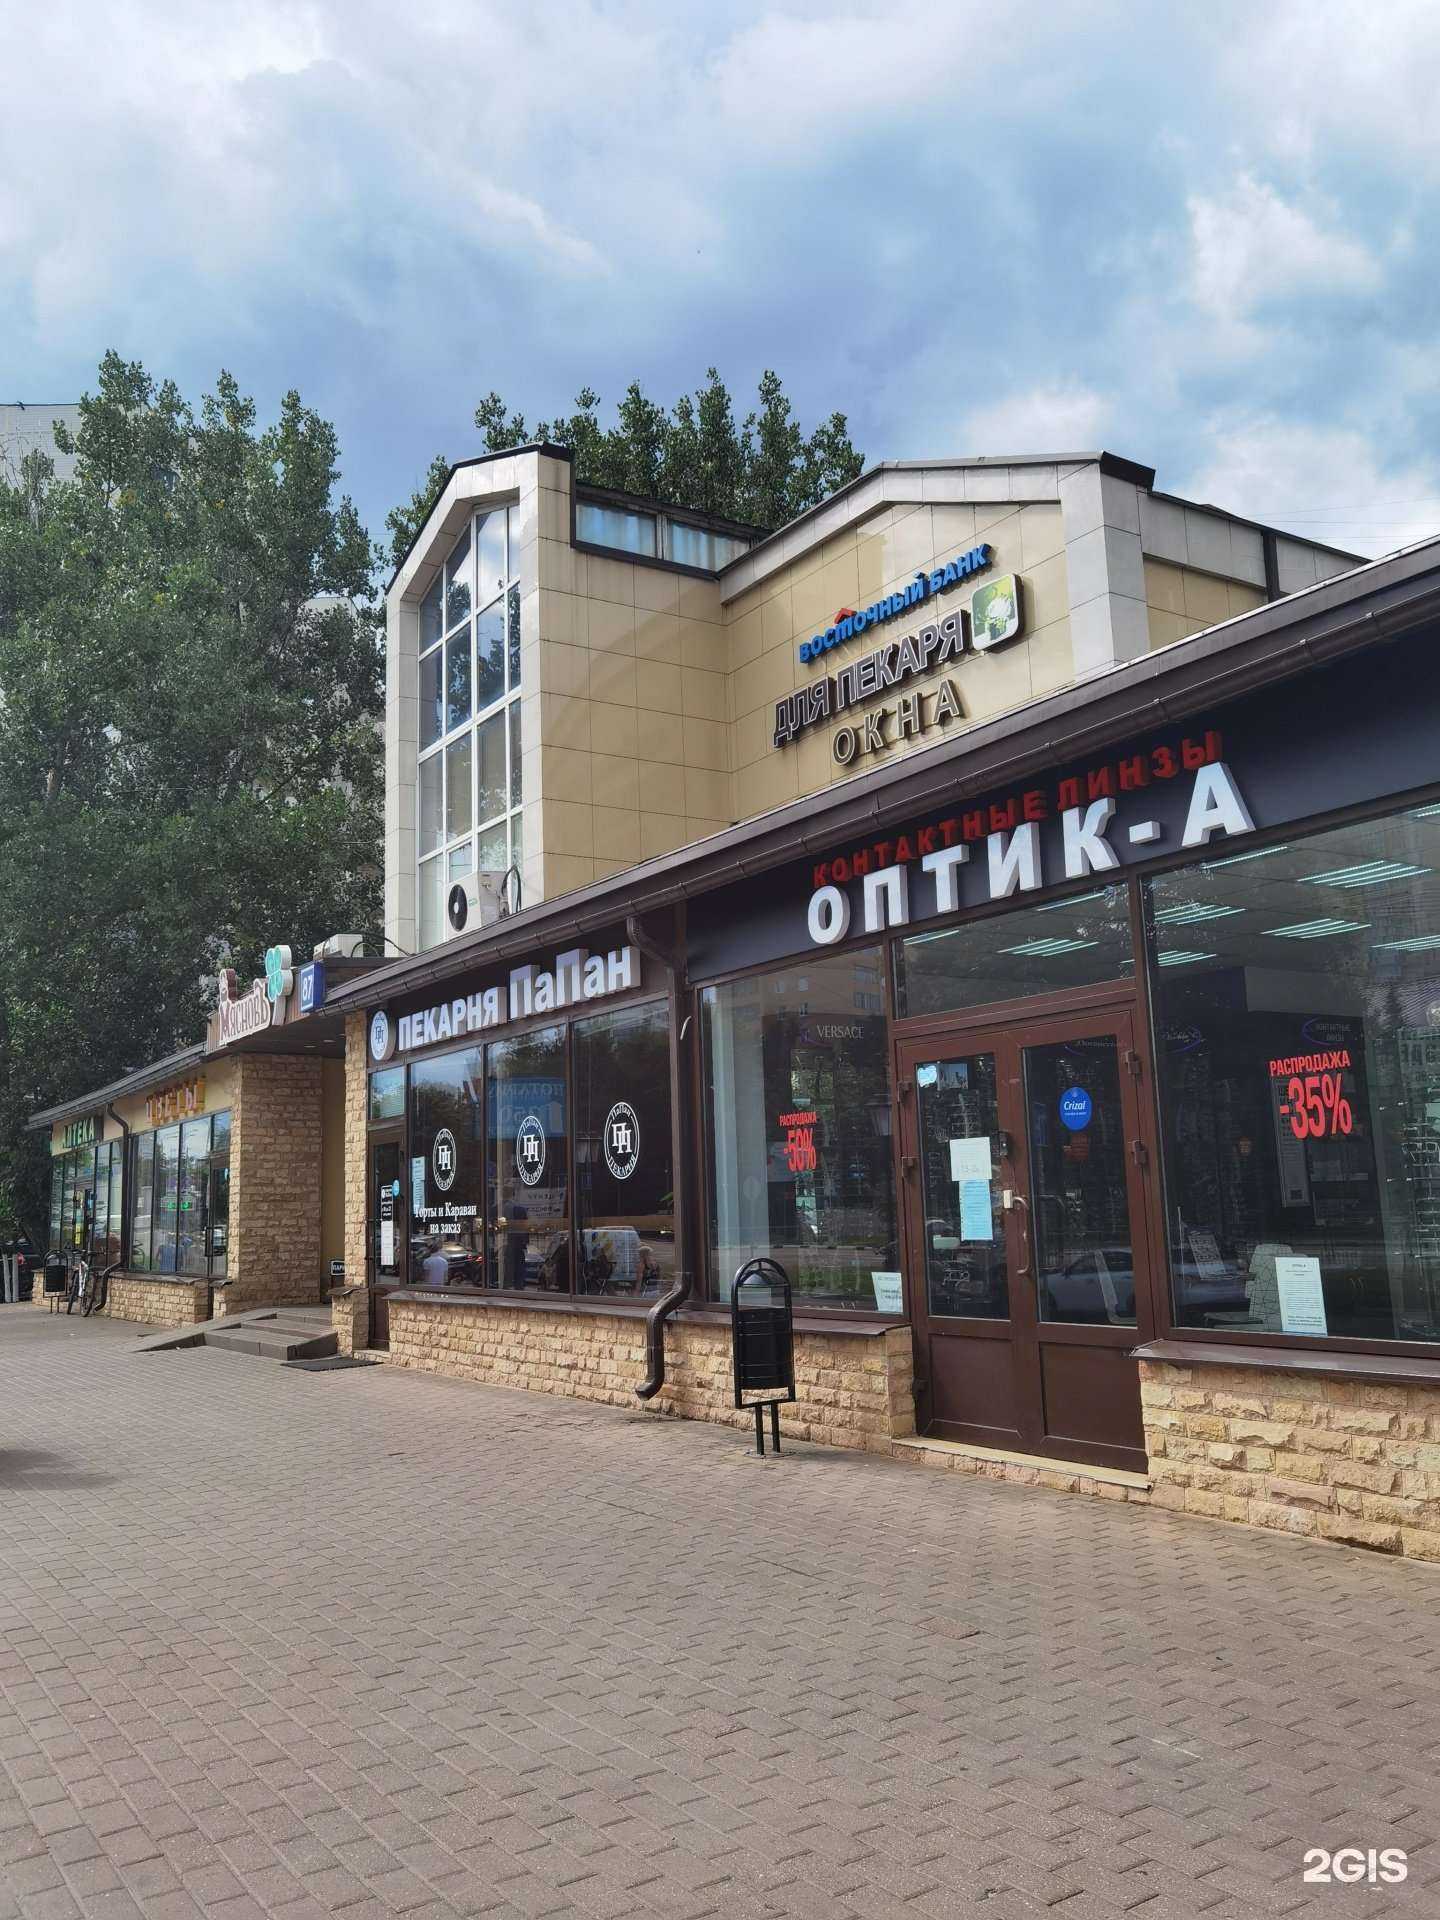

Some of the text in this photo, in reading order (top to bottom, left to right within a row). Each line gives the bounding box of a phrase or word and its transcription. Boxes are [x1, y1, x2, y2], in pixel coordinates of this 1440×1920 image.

[929, 543, 992, 593] БАНК
[773, 609, 970, 748] ДЛЯ ПЕКАРЯ
[832, 679, 963, 766] ОКНА
[813, 731, 1222, 888] КОНТАКТНЫЕ ЛИНЗЫ
[807, 762, 1256, 944] ОПТИК-А
[302, 976, 313, 1002] 87
[398, 946, 640, 1051] ПЕКАРНЯ ПаПан
[816, 1024, 865, 1039] VERSACE
[1269, 1050, 1351, 1076] РАСПРОДАЖА
[779, 1111, 817, 1127] РАСПРОДАЖА
[1063, 1101, 1086, 1111] Crizal
[1279, 1073, 1353, 1140] -35%
[415, 1206, 437, 1222] Торты
[430, 1223, 462, 1234] на заказ
